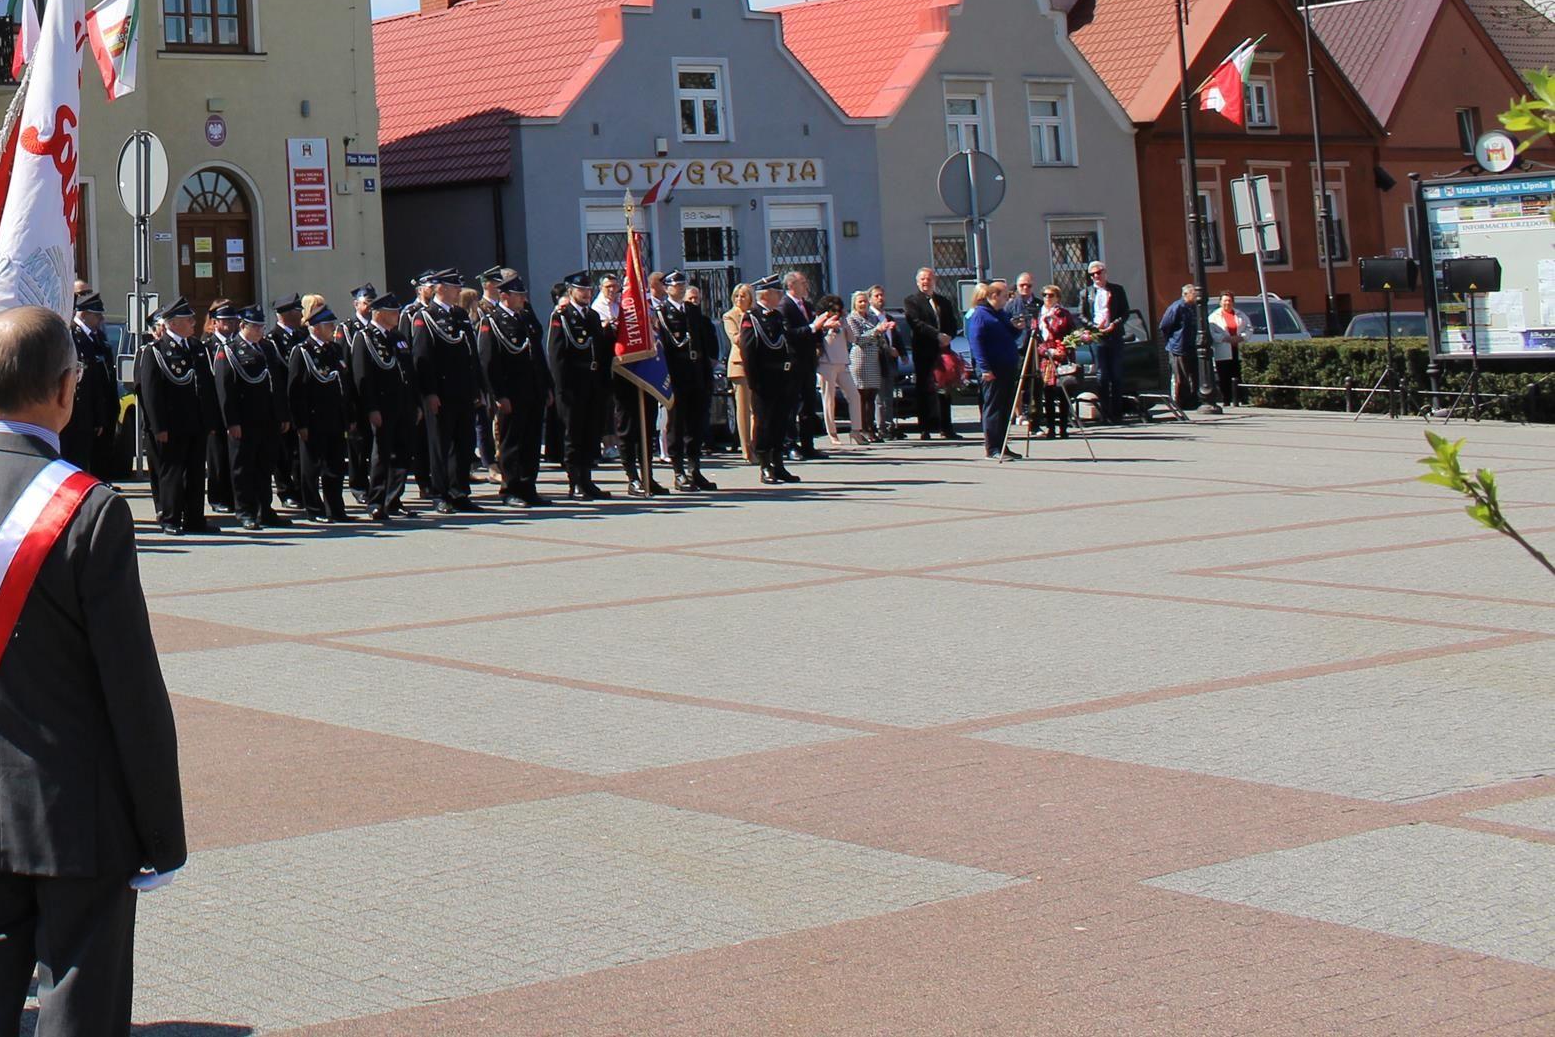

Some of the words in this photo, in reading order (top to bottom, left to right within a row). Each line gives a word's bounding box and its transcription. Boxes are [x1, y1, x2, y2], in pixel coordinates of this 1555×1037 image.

[1481, 183, 1510, 194] Miejski
[1521, 181, 1548, 192] Lipnie
[749, 198, 757, 211] 9
